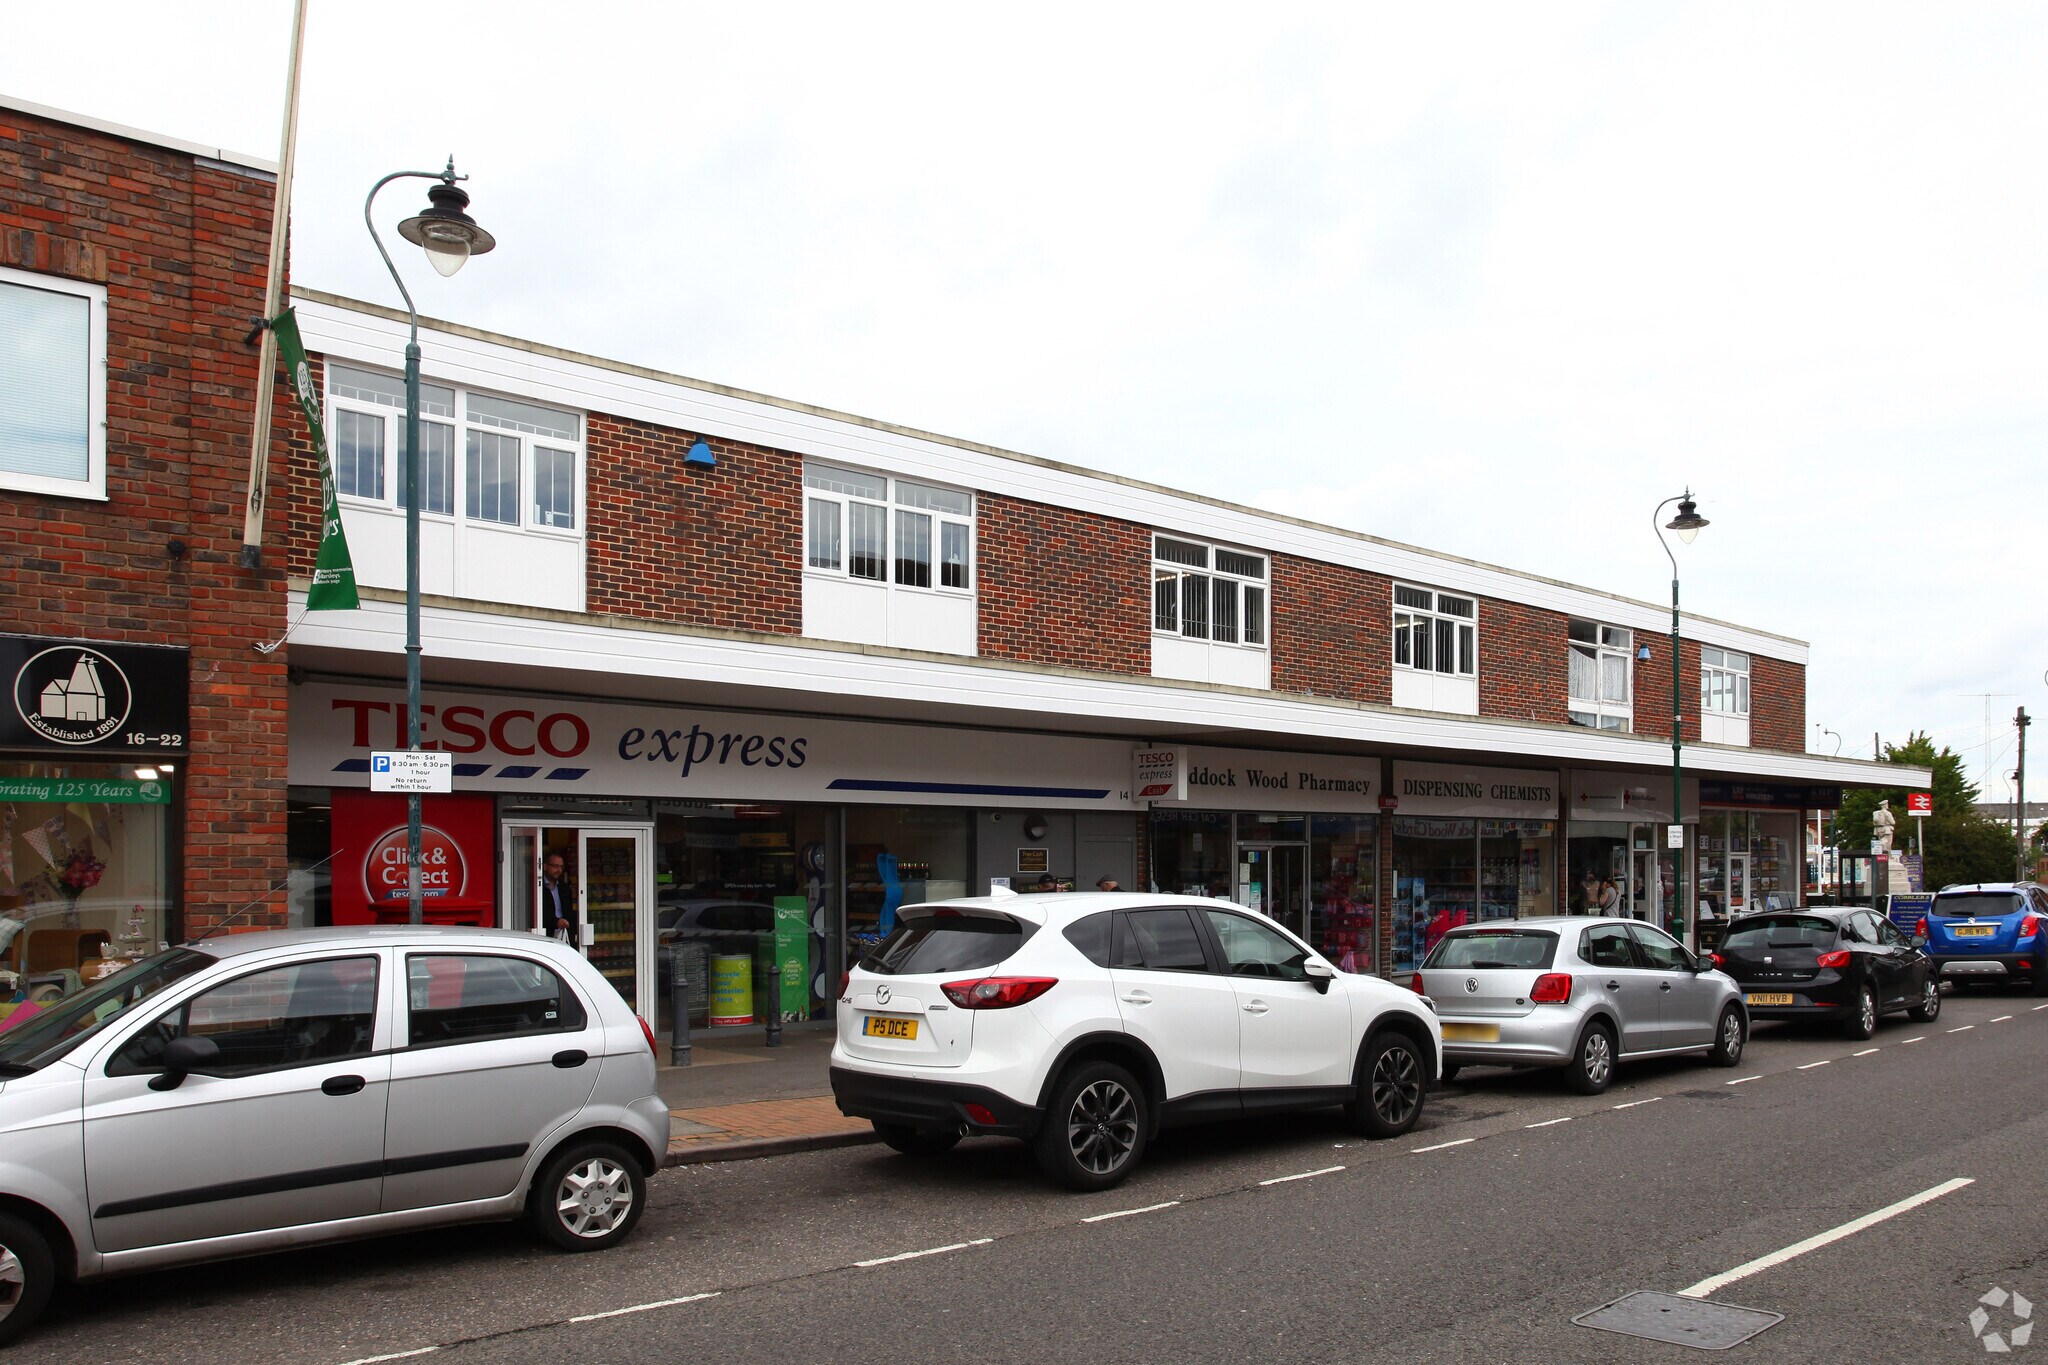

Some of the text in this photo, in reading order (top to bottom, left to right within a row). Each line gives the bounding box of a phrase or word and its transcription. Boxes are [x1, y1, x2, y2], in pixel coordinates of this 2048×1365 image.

[28, 712, 119, 740] Established 1891
[332, 699, 807, 777] TESCO express
[1138, 752, 1174, 763] TESCO
[1139, 769, 1173, 782] express
[1188, 767, 1371, 796] ddock Wood Pharmacy
[0, 782, 133, 799] rating 125 Years
[1120, 791, 1128, 800] 14
[1147, 786, 1164, 795] Cash
[1403, 779, 1551, 802] DISPENSING CHEMISTS
[382, 847, 447, 865] Clik &
[382, 866, 449, 885] Coect
[1769, 995, 1787, 1003] HVB
[873, 1019, 909, 1036] P5 DCE
